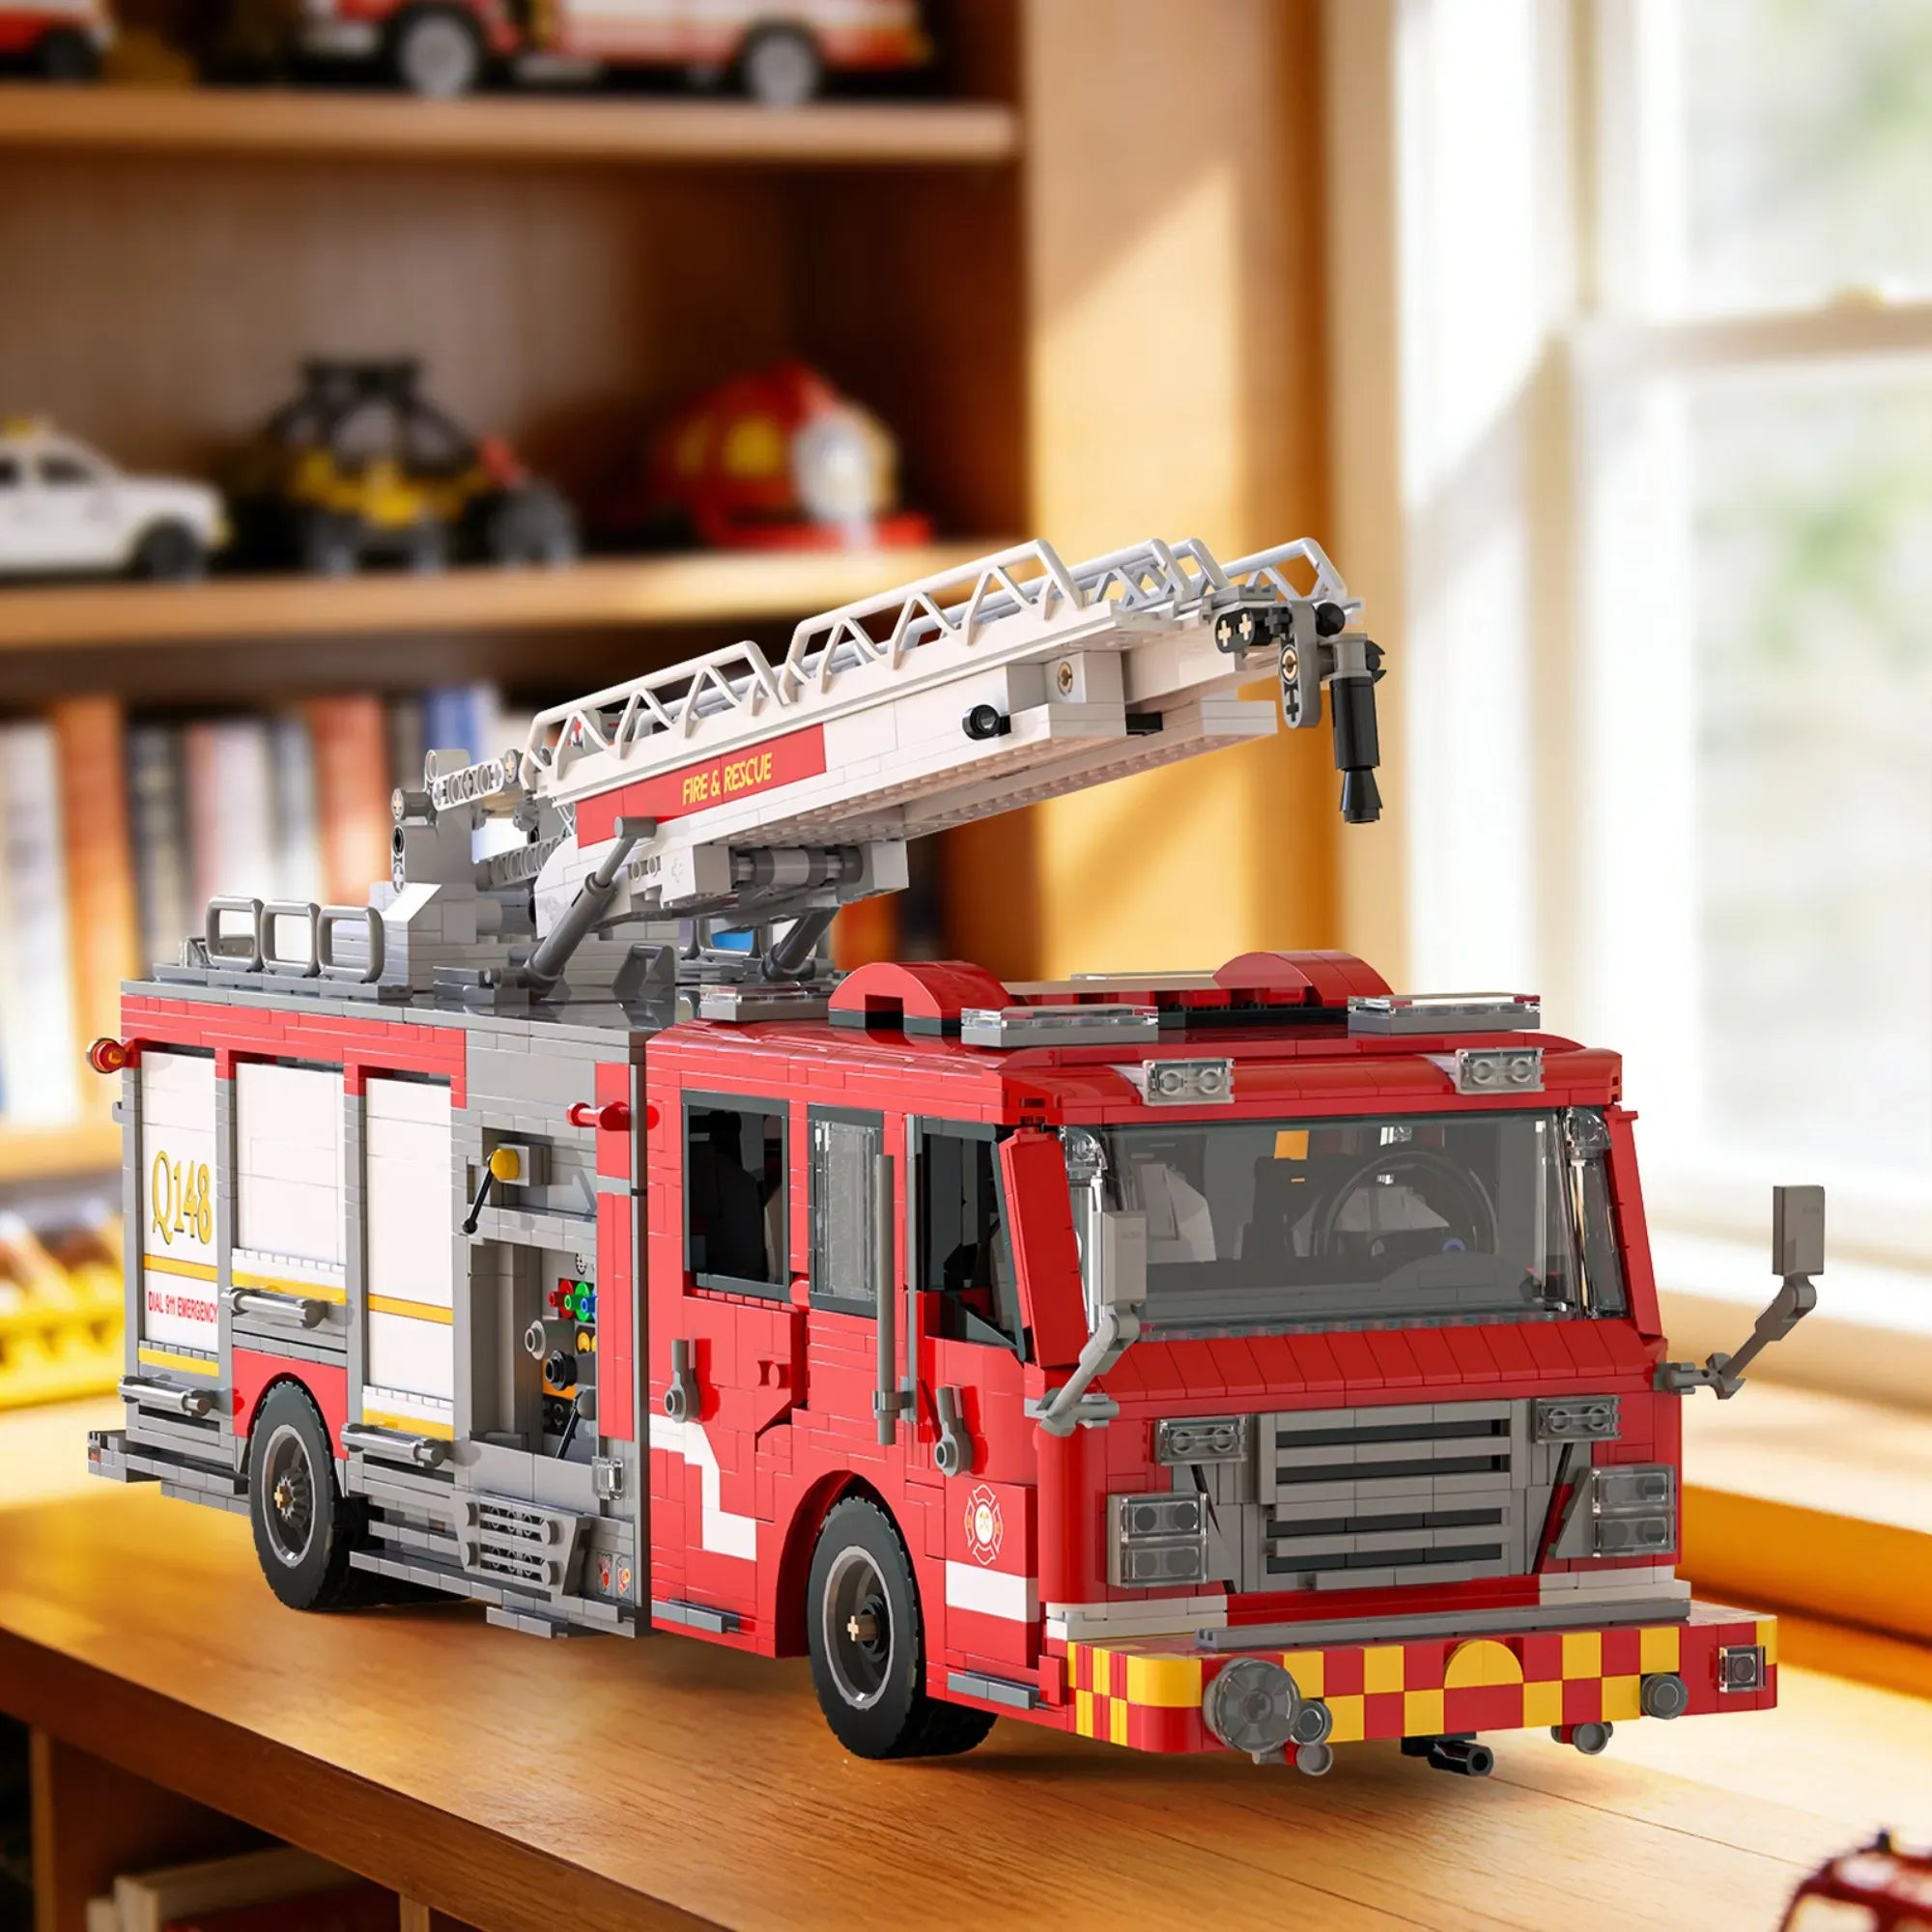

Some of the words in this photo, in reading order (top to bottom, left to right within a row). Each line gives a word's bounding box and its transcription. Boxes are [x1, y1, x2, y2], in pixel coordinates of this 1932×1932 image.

[682, 773, 708, 806] FIRE
[710, 769, 721, 796] &
[724, 753, 773, 794] RESCUE
[152, 1151, 213, 1245] Q148
[149, 1291, 163, 1314] DIAL
[165, 1294, 175, 1315] 911
[178, 1296, 218, 1323] EMERGENCY
